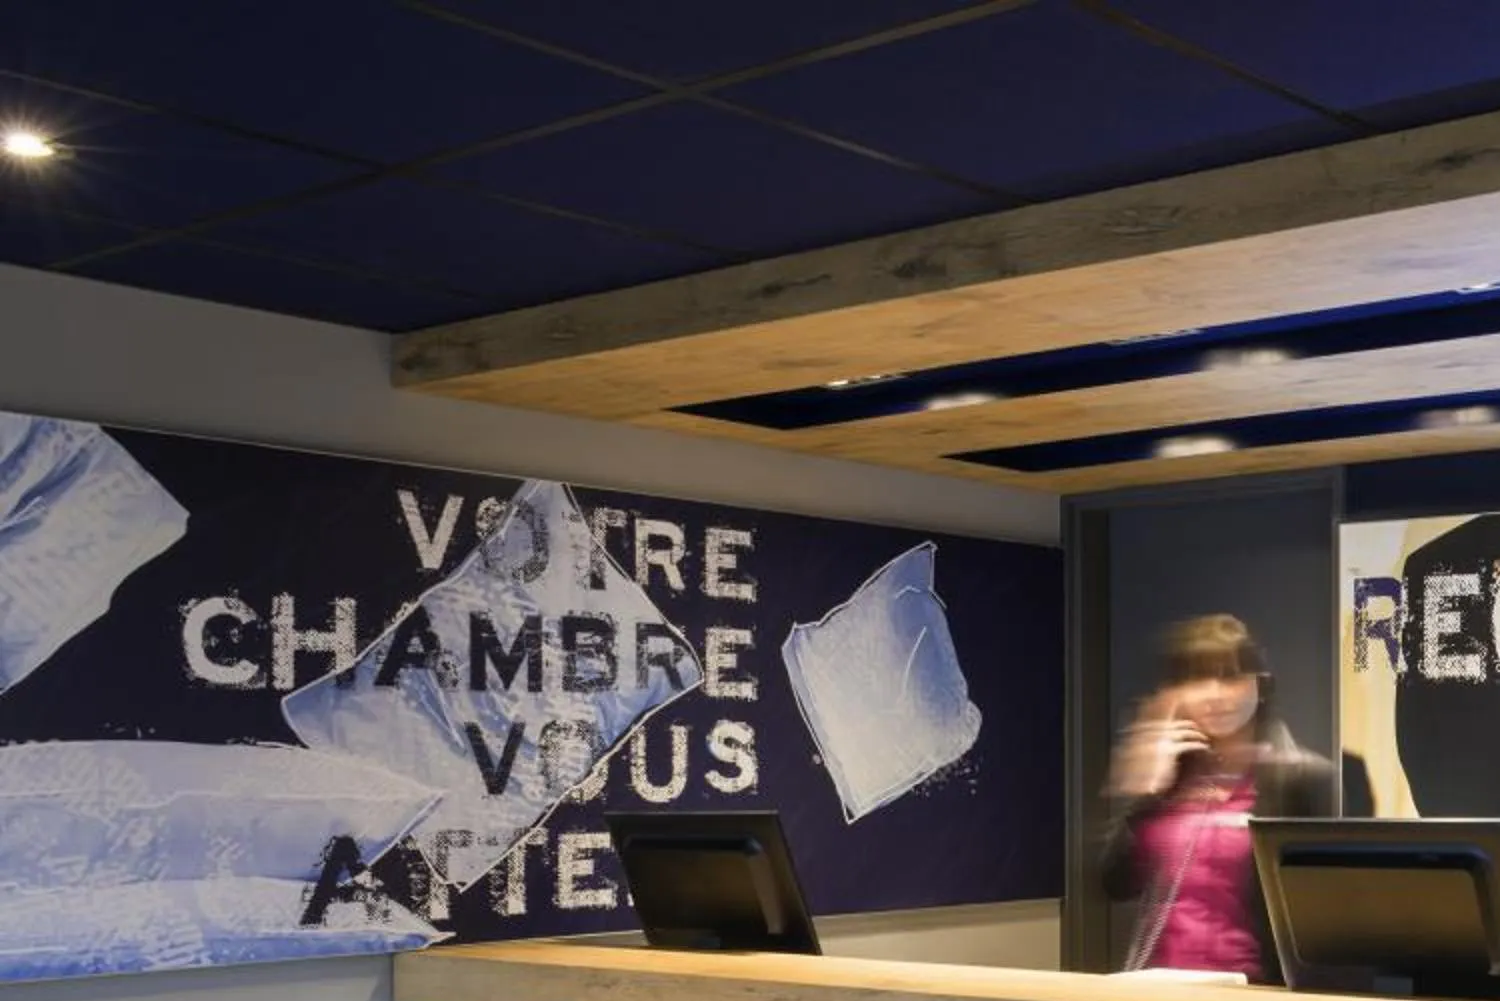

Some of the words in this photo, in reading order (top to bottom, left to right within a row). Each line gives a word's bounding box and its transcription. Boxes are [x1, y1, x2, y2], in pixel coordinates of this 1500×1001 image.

[396, 488, 757, 602] VOTRE
[180, 590, 757, 701] CHAMBRE
[464, 719, 758, 804] VOUS
[300, 834, 634, 927] ATTE
